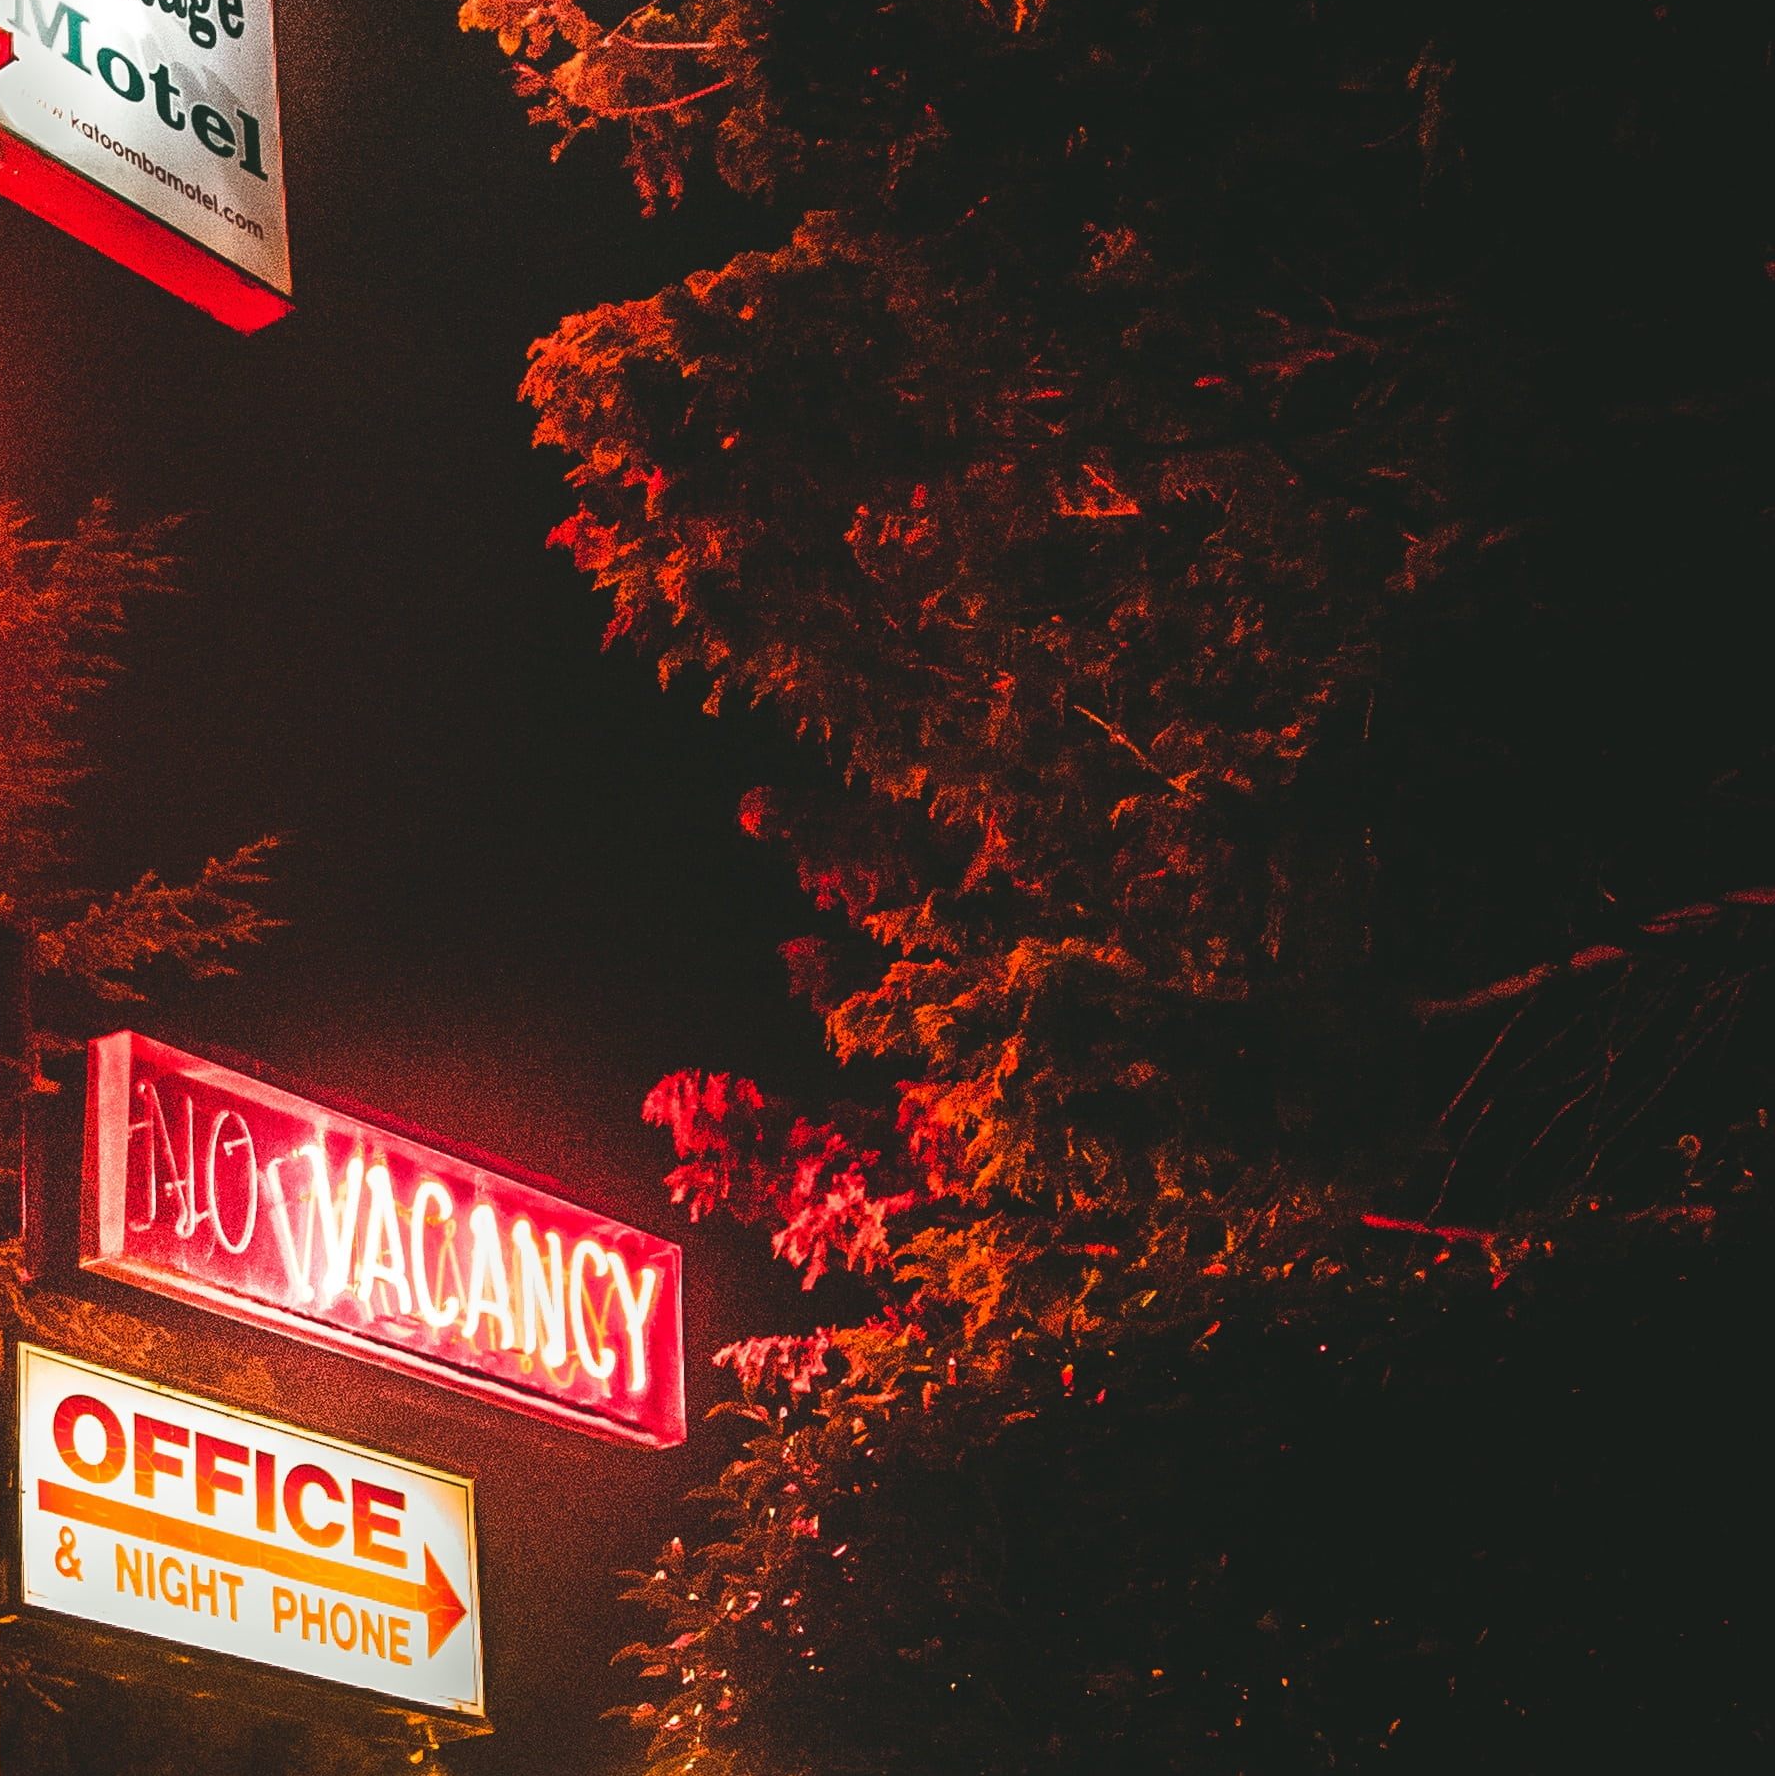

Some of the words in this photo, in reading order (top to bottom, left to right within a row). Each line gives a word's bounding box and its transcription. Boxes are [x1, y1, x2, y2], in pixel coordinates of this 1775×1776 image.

[22, 89, 265, 241] wkatoombamotel.com
[126, 1081, 258, 1255] NO
[296, 1142, 657, 1393] VACANCY
[51, 1393, 409, 1571] OFFICE
[54, 1525, 84, 1583] &
[114, 1542, 245, 1623] NIGHT
[271, 1586, 414, 1667] PHONE
